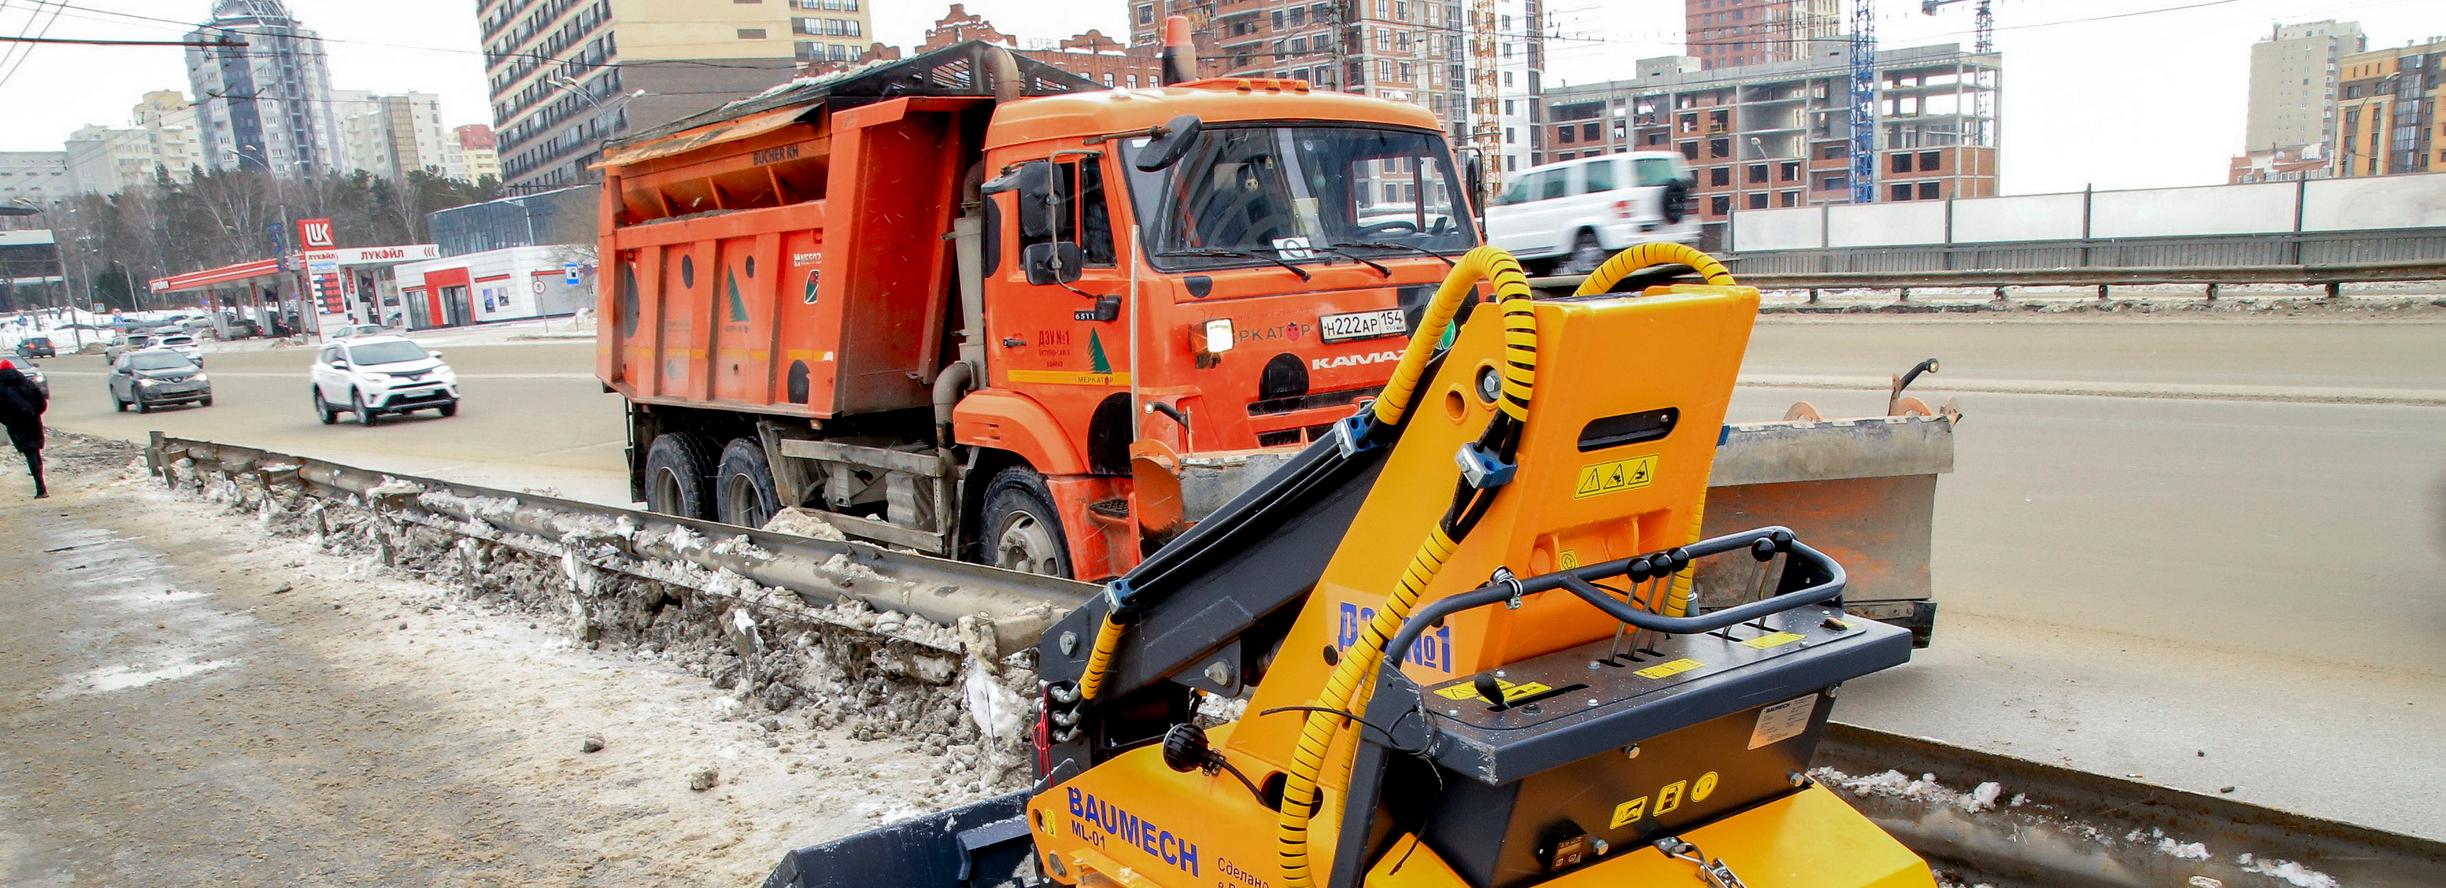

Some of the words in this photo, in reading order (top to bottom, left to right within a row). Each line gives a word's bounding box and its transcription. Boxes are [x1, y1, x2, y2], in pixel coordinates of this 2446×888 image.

[361, 248, 404, 260] ЛУКОЙЛ
[1327, 316, 1377, 336] Н222АР
[1380, 311, 1402, 326] 154
[1067, 786, 1199, 878] BAUMECH
[1071, 819, 1106, 851] ML-01
